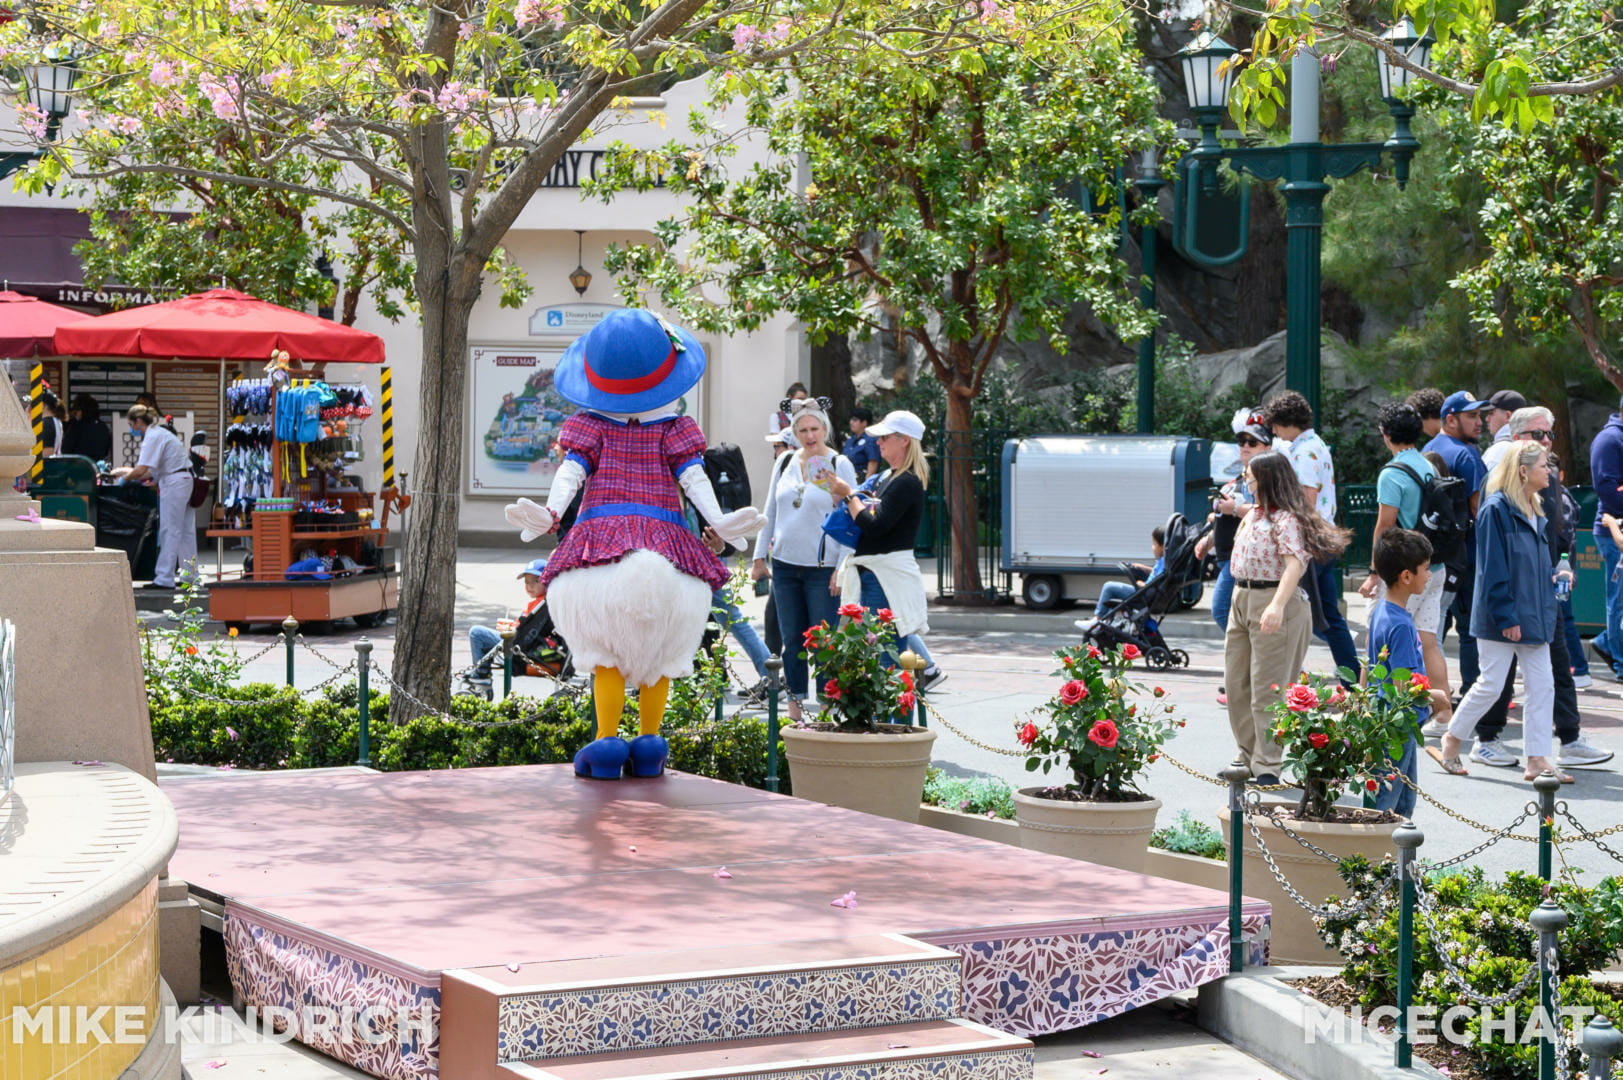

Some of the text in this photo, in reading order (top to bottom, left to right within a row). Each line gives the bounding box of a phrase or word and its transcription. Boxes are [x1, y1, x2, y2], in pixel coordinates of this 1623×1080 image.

[565, 311, 604, 320] Disneyland
[497, 358, 536, 366] GUIDE MAP
